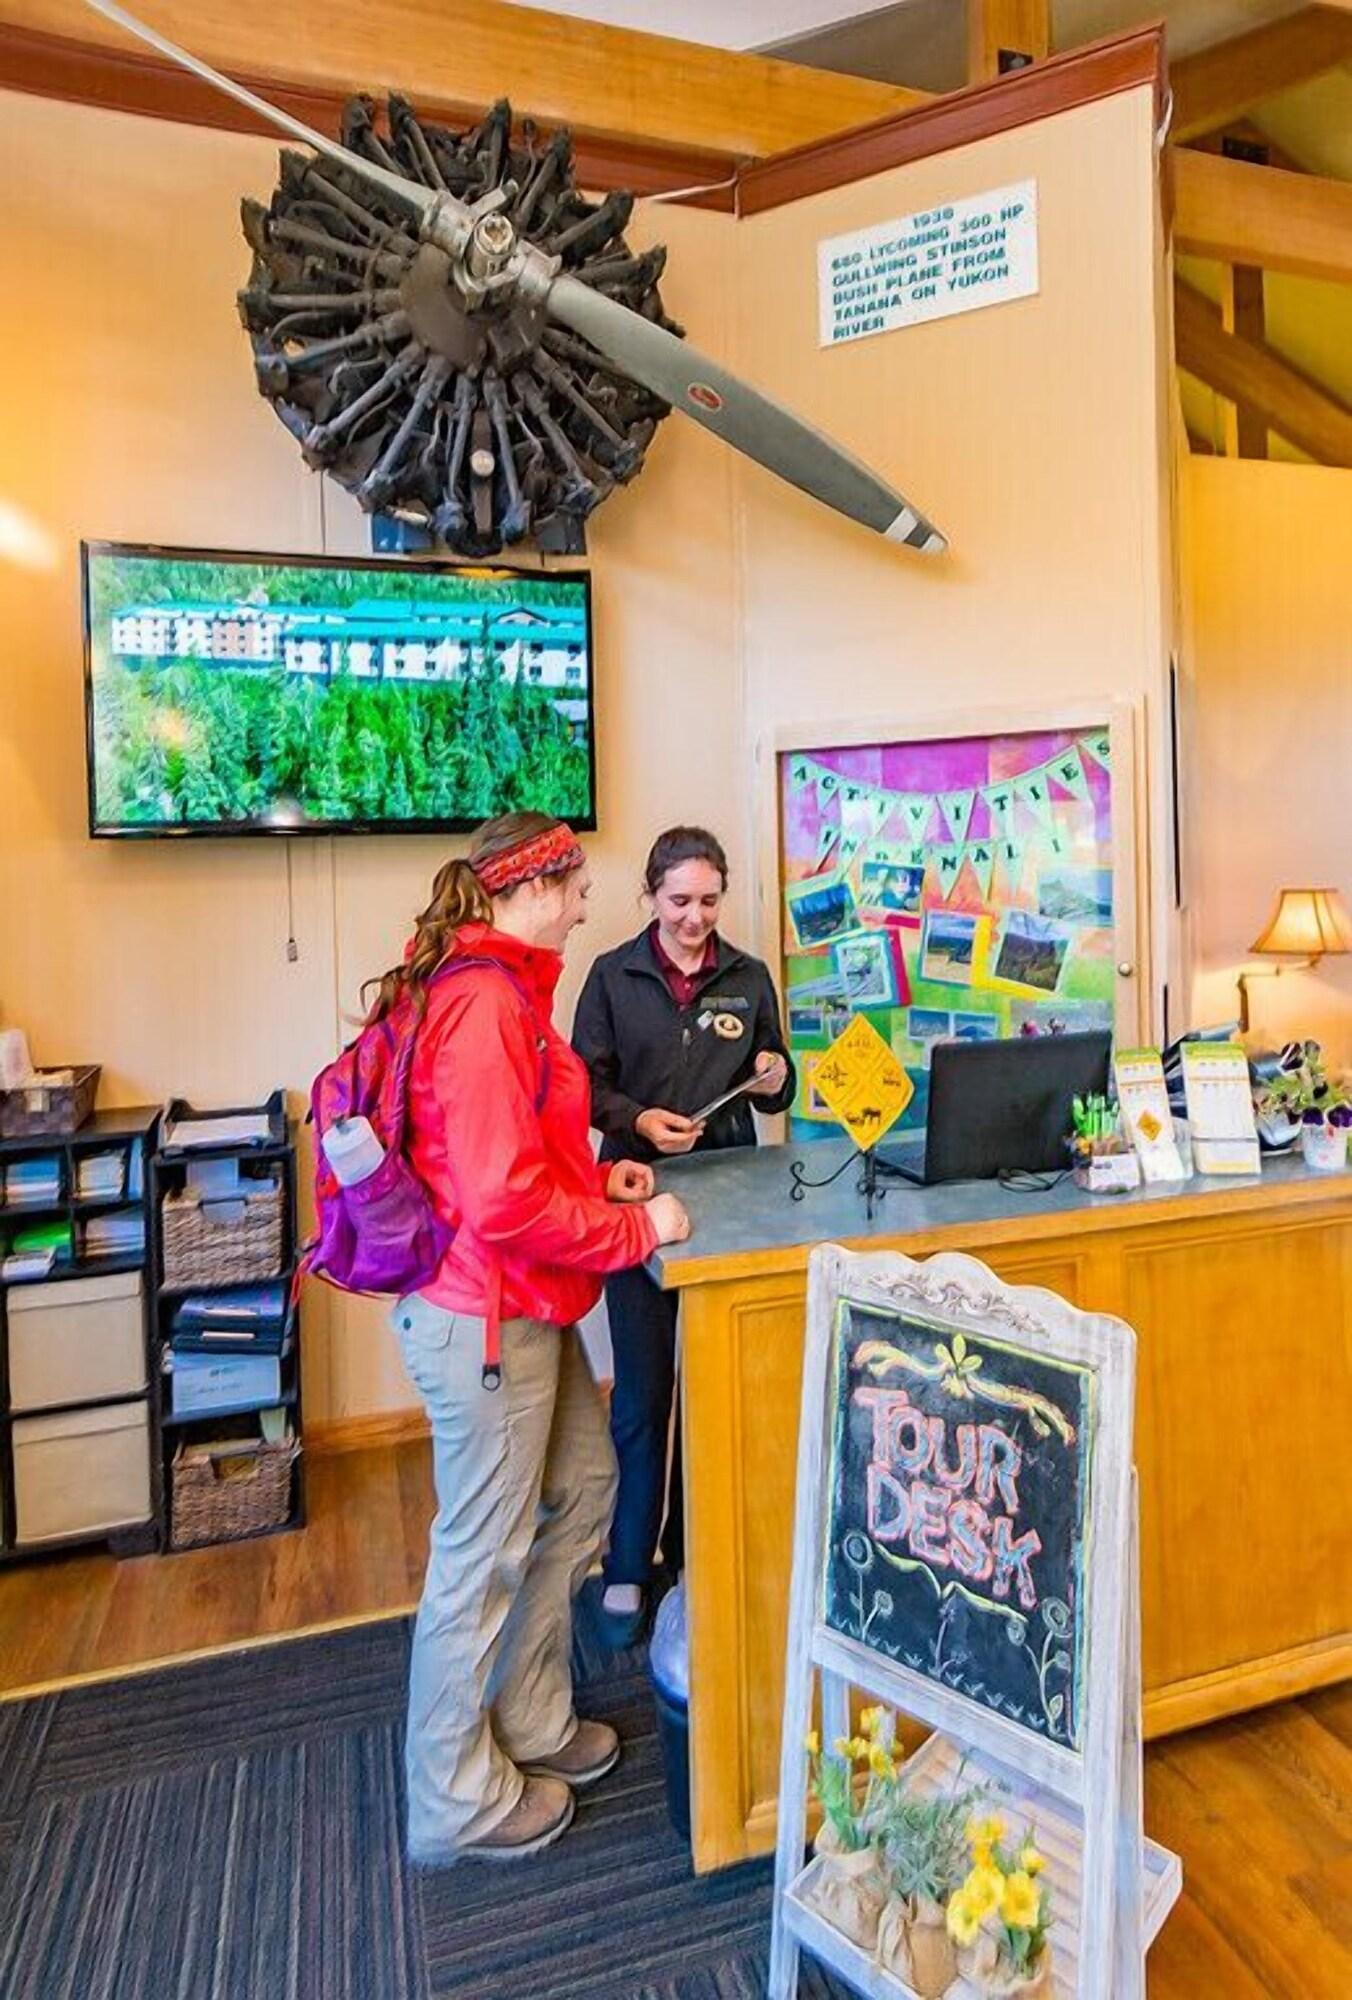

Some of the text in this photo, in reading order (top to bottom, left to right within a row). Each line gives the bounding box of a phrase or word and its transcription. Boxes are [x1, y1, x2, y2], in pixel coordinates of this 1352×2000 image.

[832, 228, 1007, 287] GULLWING STINSON
[869, 227, 950, 260] LYCOMING
[960, 214, 992, 233] 300
[1000, 203, 1024, 221] HP
[833, 247, 1006, 305] BUSH PLANE FROM
[833, 264, 1009, 321] TANANA ON YUKON
[833, 316, 884, 339] RIVER
[793, 742, 1110, 820] ACTIVITIES
[822, 830, 858, 853] IN
[853, 1386, 1022, 1515] TOUR
[867, 1464, 1042, 1609] DESK
